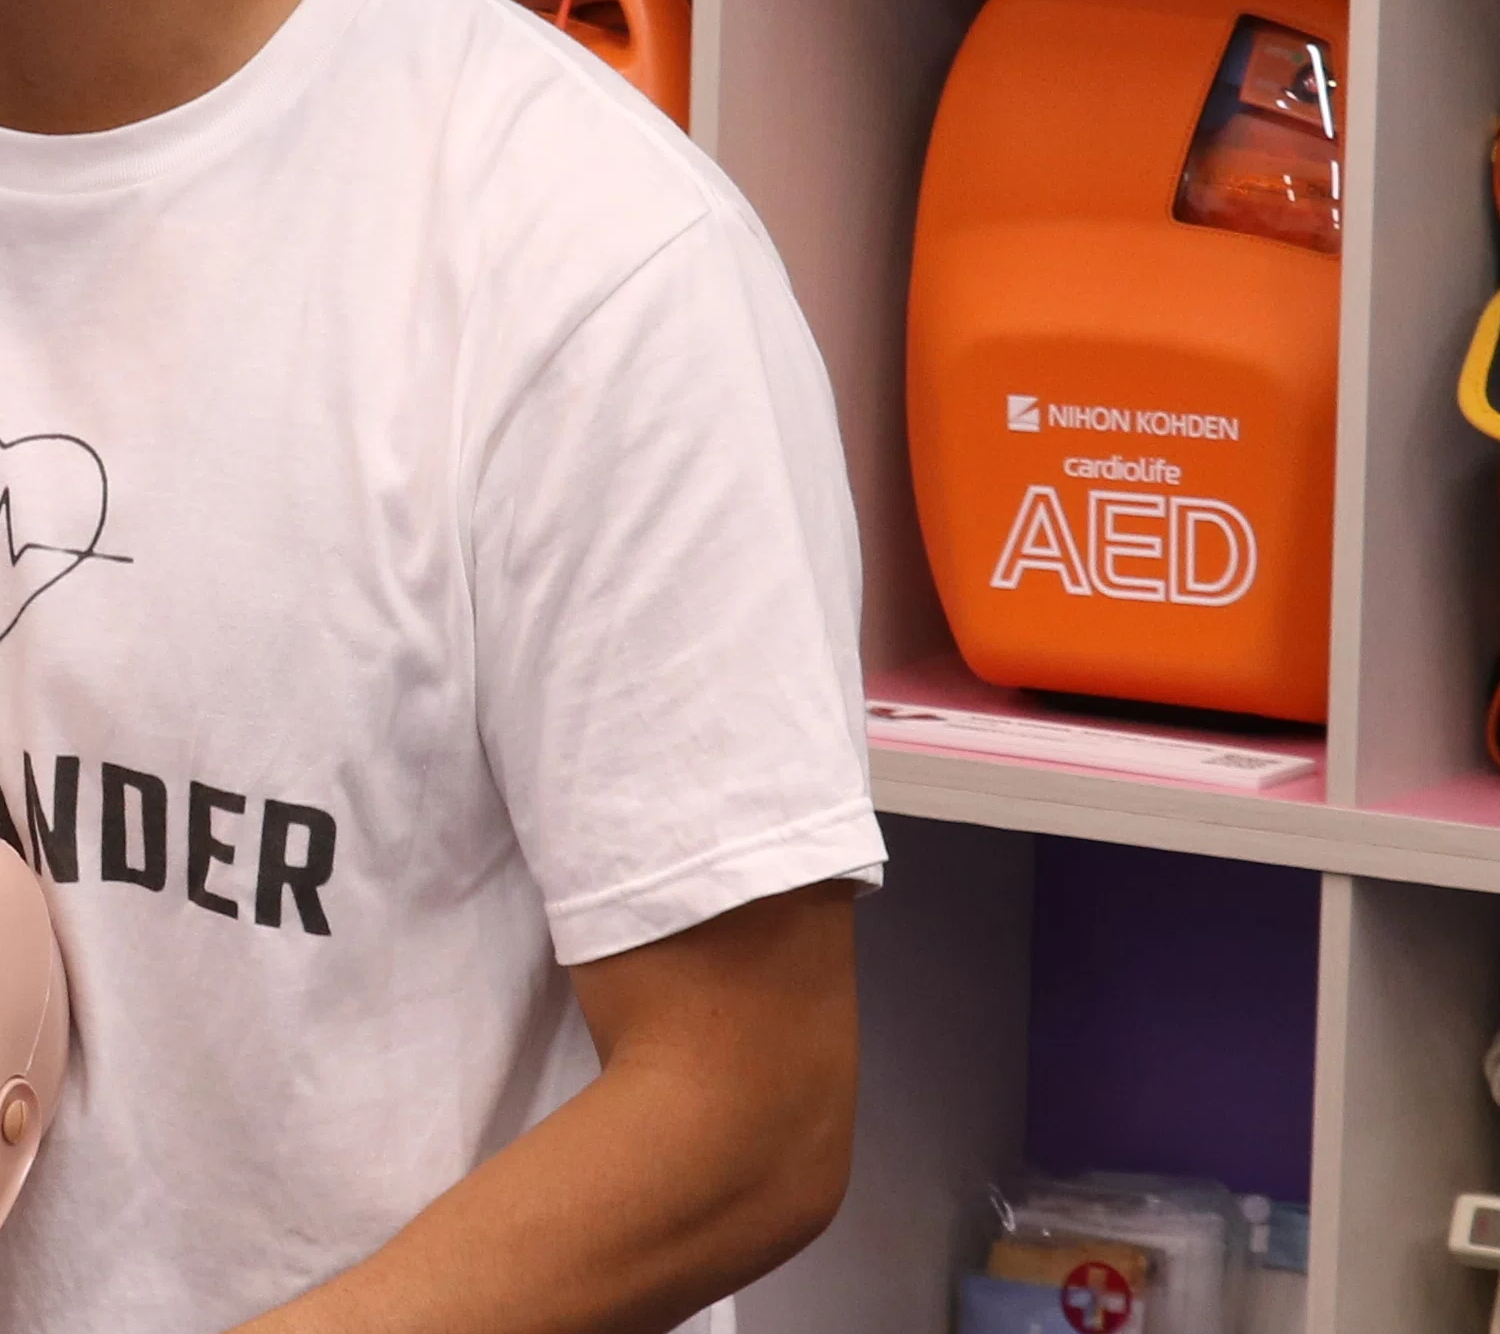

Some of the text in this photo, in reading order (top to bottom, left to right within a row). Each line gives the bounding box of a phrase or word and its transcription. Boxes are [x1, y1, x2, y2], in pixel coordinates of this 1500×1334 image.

[1048, 403, 1240, 442] NIHON KOHDEN
[1063, 454, 1182, 486] cardiolife
[989, 484, 1258, 607] AED
